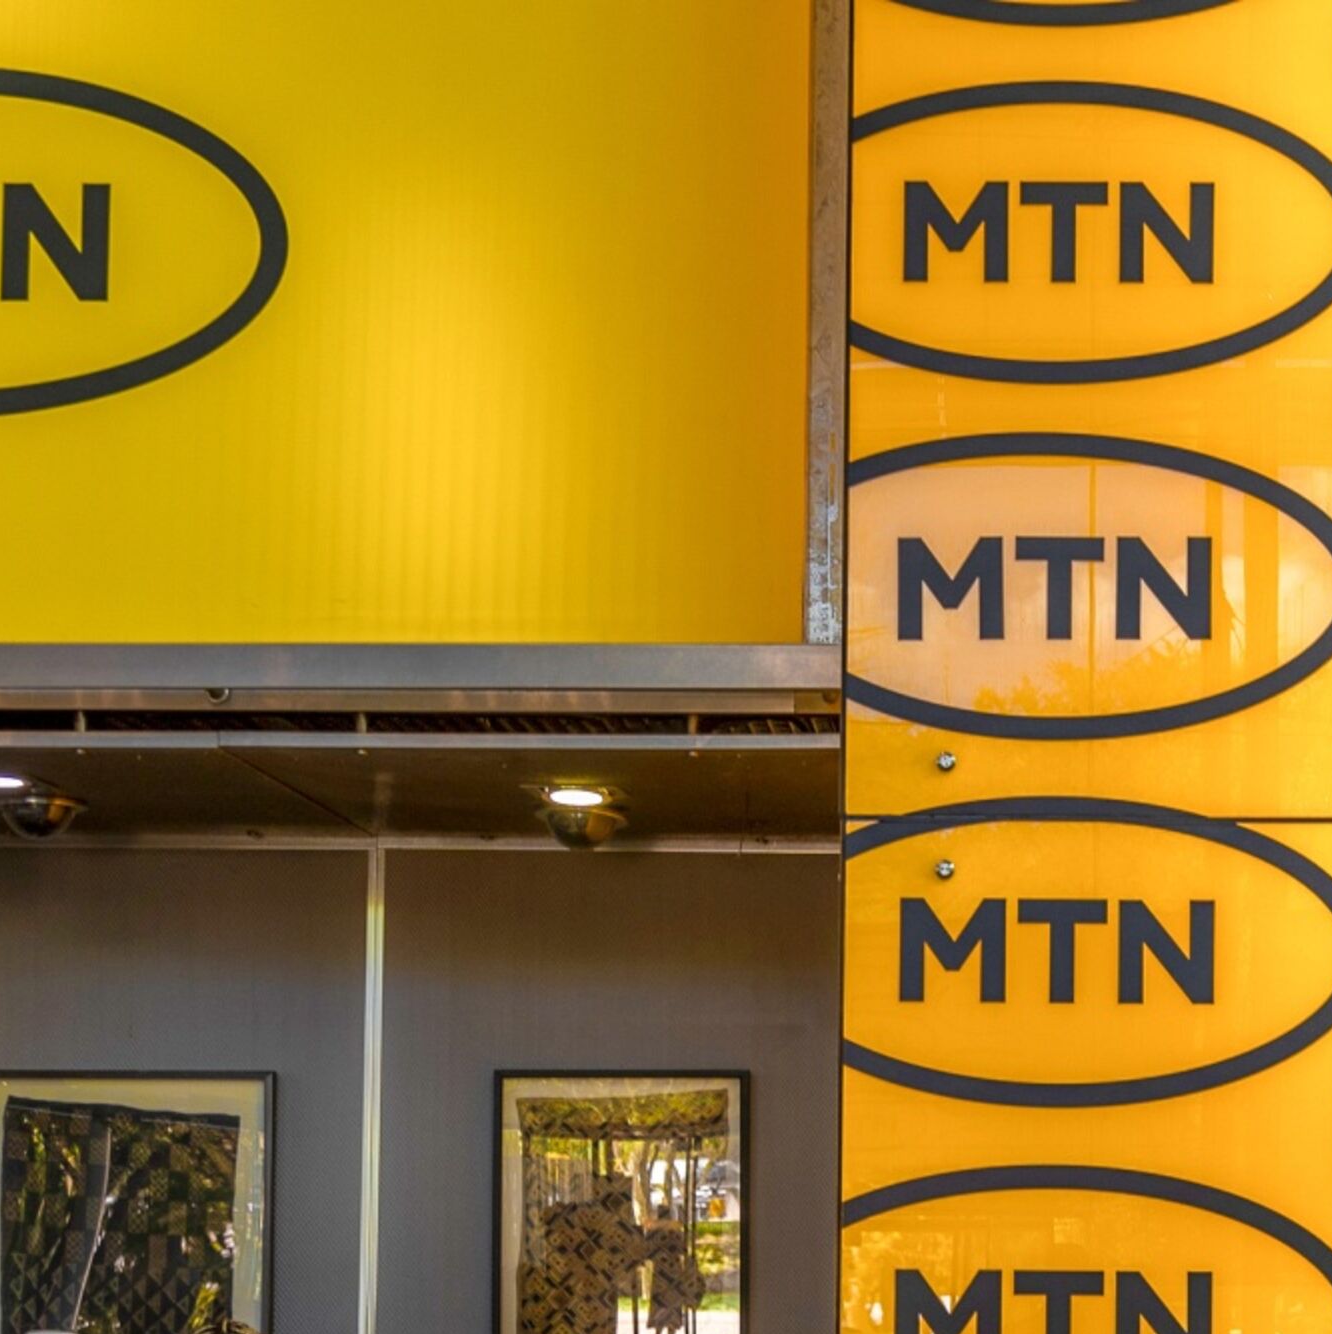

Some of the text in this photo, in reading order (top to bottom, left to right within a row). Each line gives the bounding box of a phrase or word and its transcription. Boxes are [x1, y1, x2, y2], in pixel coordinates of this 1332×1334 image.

[904, 181, 1214, 283] MTN
[898, 536, 1212, 641] MTN
[899, 897, 1215, 1004] MTN
